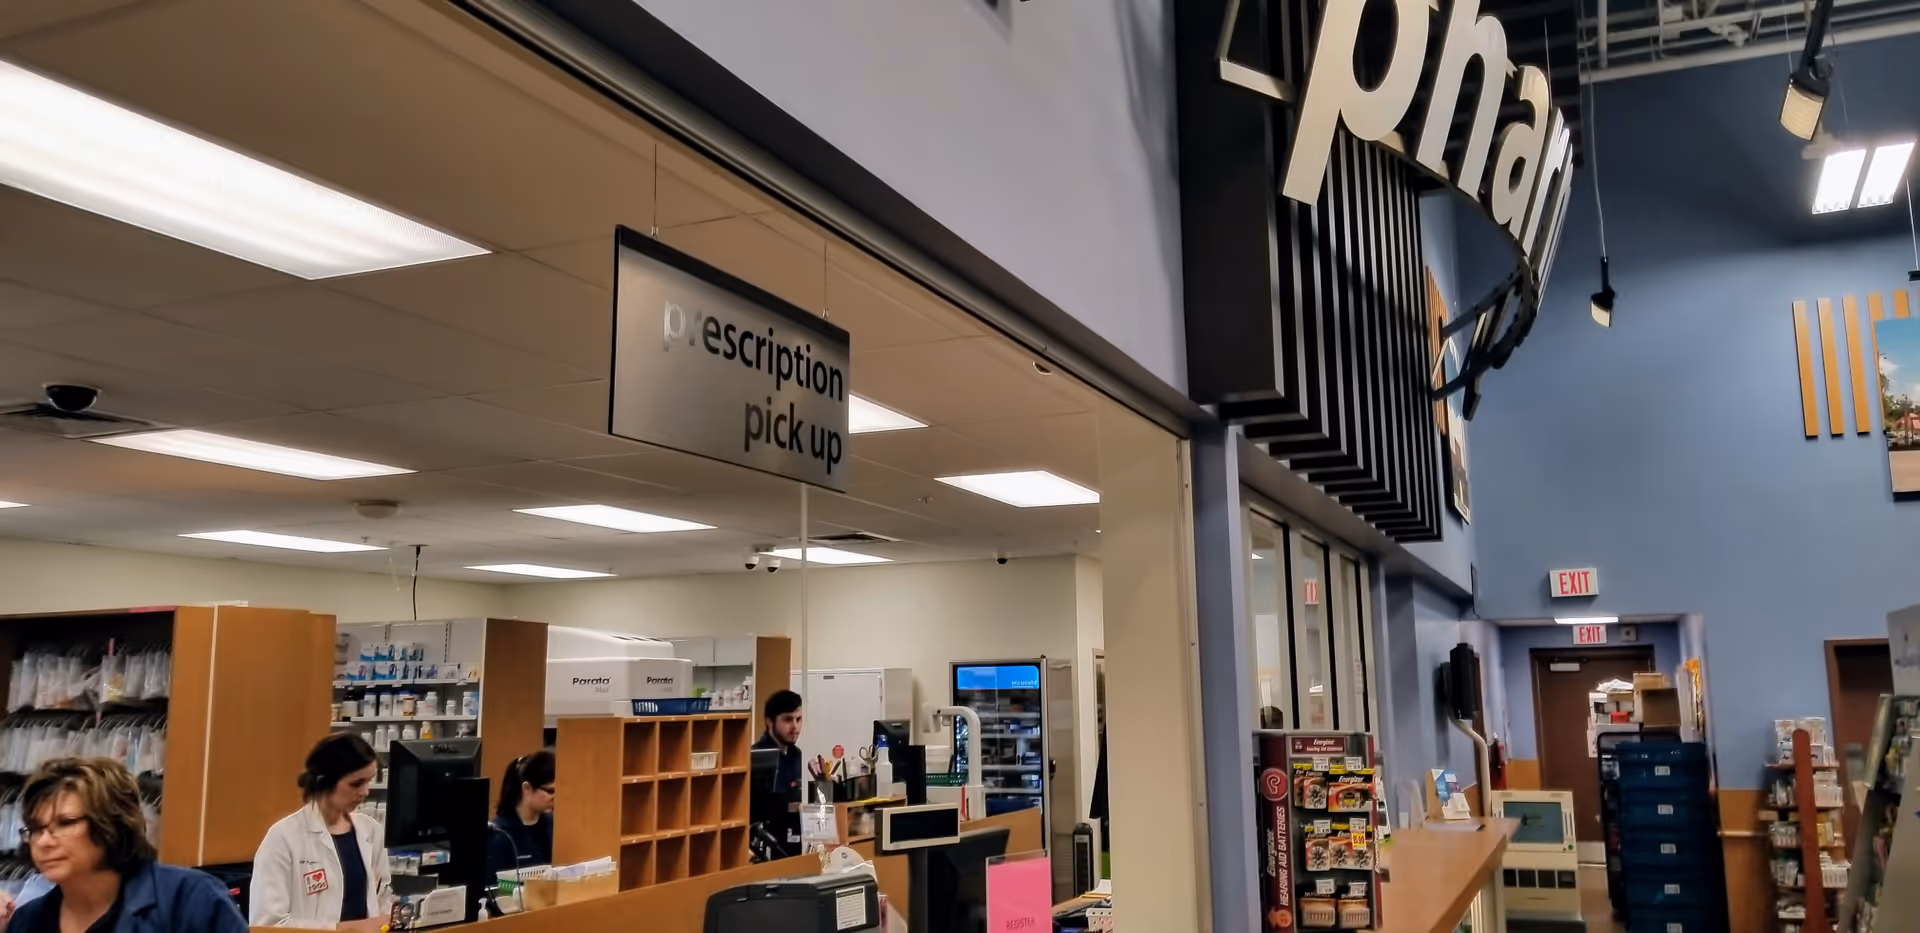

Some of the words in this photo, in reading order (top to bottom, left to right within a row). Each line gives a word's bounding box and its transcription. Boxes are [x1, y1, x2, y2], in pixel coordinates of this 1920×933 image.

[662, 299, 844, 403] prescription
[744, 397, 804, 454] pick
[810, 423, 843, 475] up
[1559, 572, 1589, 595] EXIT
[1579, 627, 1601, 643] EXIT
[572, 677, 610, 686] Parata
[1276, 806, 1287, 850] BATTERIES
[1267, 829, 1277, 877] Energizer
[1278, 851, 1288, 868] AID
[1279, 867, 1289, 906] HEARING
